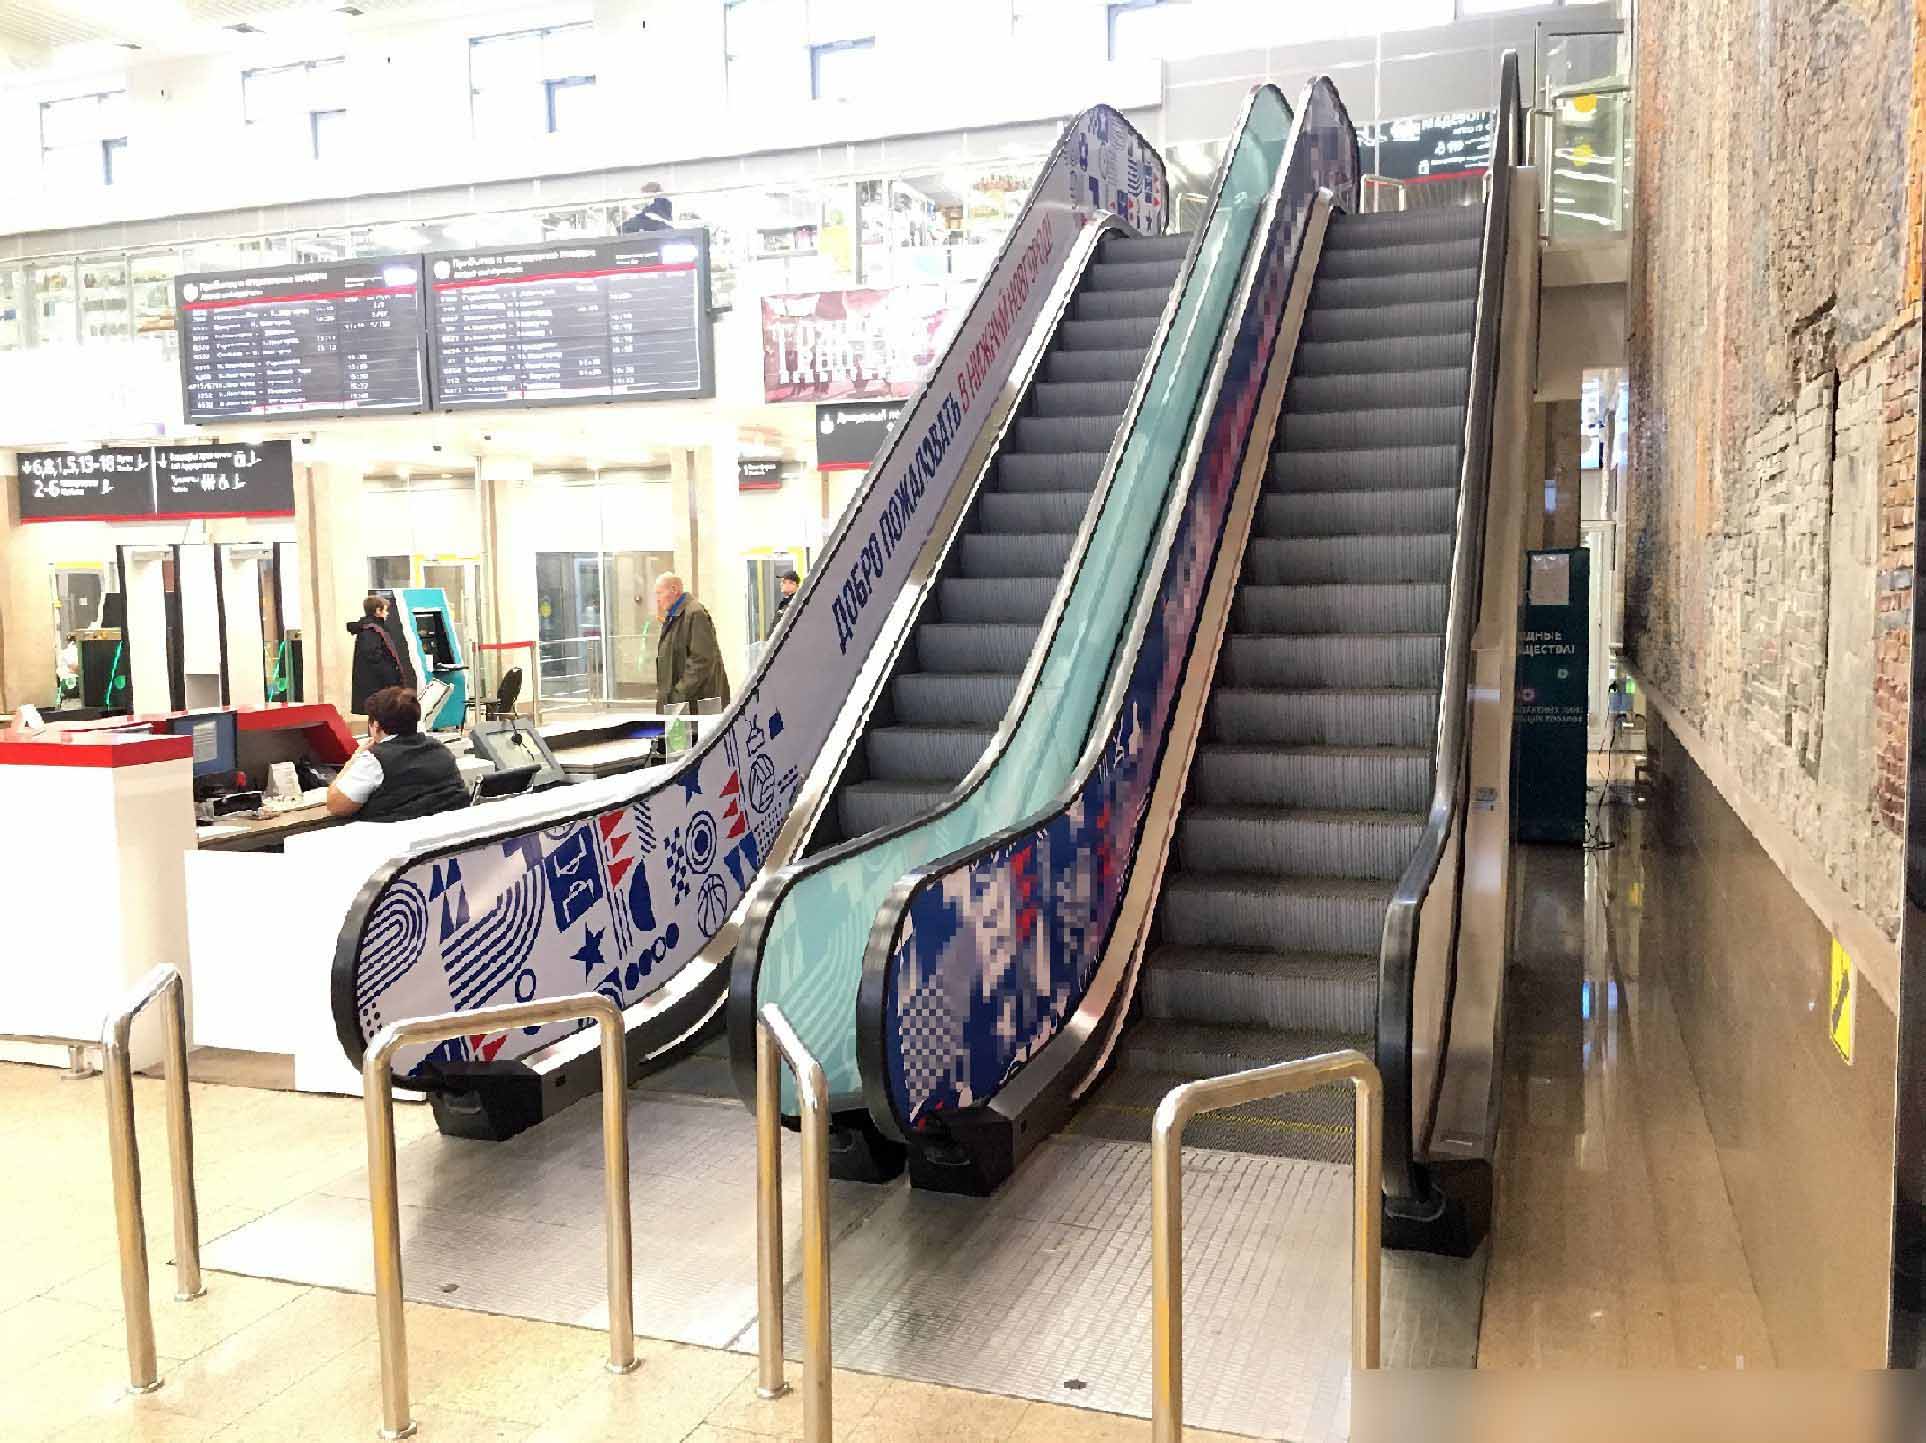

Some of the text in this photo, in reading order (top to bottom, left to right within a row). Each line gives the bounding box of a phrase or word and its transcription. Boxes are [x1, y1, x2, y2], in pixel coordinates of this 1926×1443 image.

[832, 211, 1054, 656] ДОБРО ПОЖАЛОВАТЬ В НИЖНИЙ НОВГОРОД
